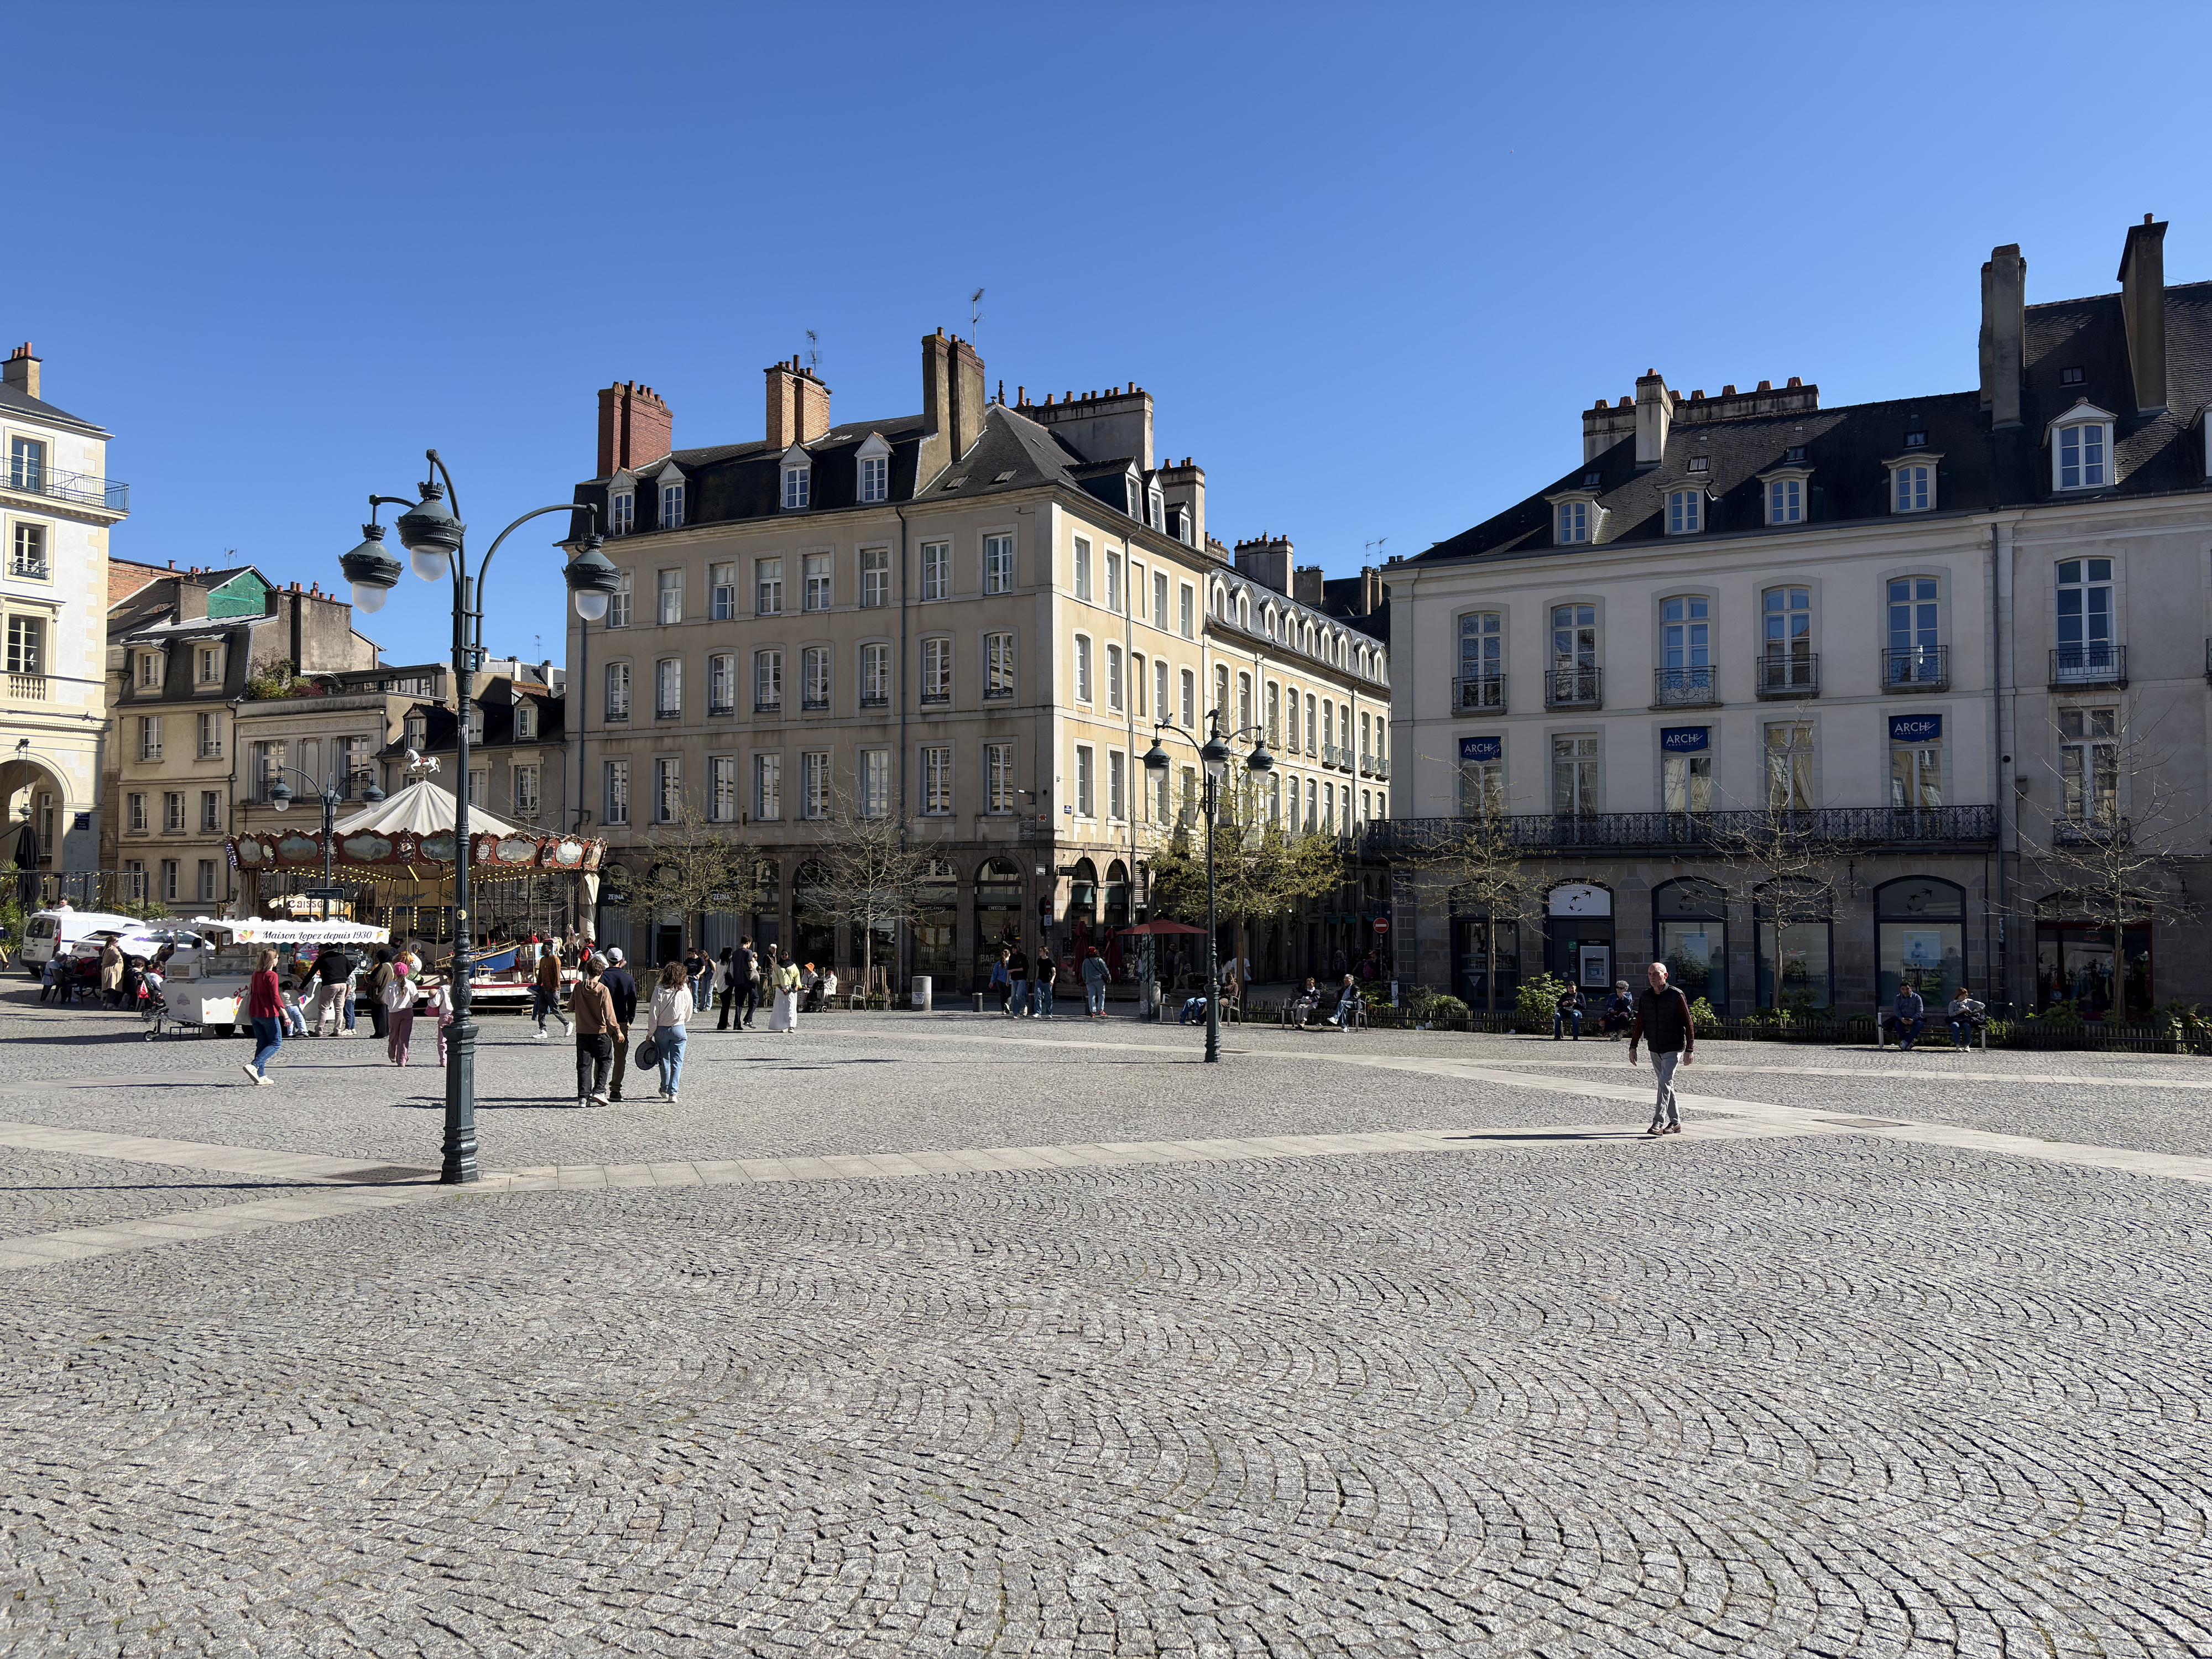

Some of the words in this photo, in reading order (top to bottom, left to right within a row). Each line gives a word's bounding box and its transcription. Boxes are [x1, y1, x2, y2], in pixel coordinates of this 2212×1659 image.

[263, 931, 296, 940] Maison
[298, 931, 321, 941] Lopez
[324, 931, 350, 941] depuis
[980, 954, 995, 963] BAR
